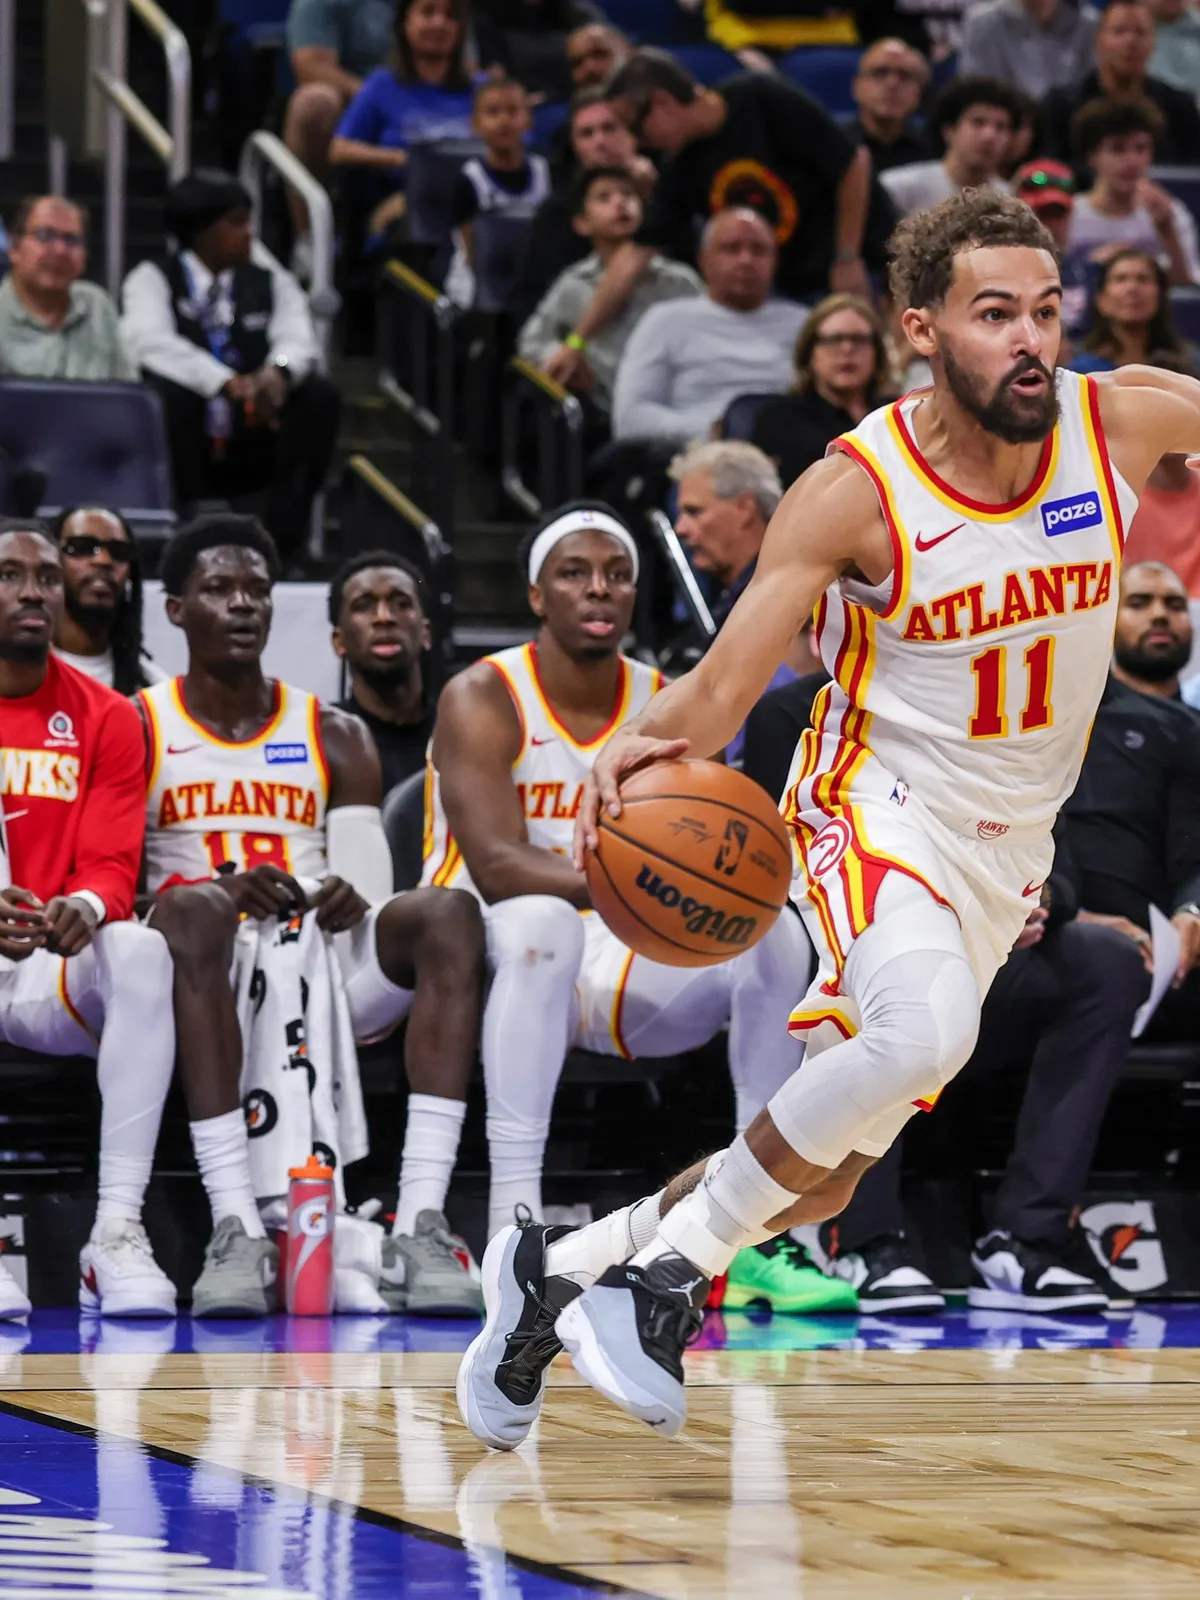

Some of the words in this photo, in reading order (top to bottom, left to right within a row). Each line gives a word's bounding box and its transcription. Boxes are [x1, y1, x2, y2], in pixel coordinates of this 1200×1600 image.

[1045, 500, 1098, 530] paze
[901, 560, 1113, 642] ATLANTA
[968, 634, 1056, 740] 11
[158, 780, 318, 829] ATLANTA
[976, 820, 1010, 835] HAWKS
[203, 830, 293, 876] 18
[635, 863, 758, 945] Wilson
[299, 1204, 328, 1237] G
